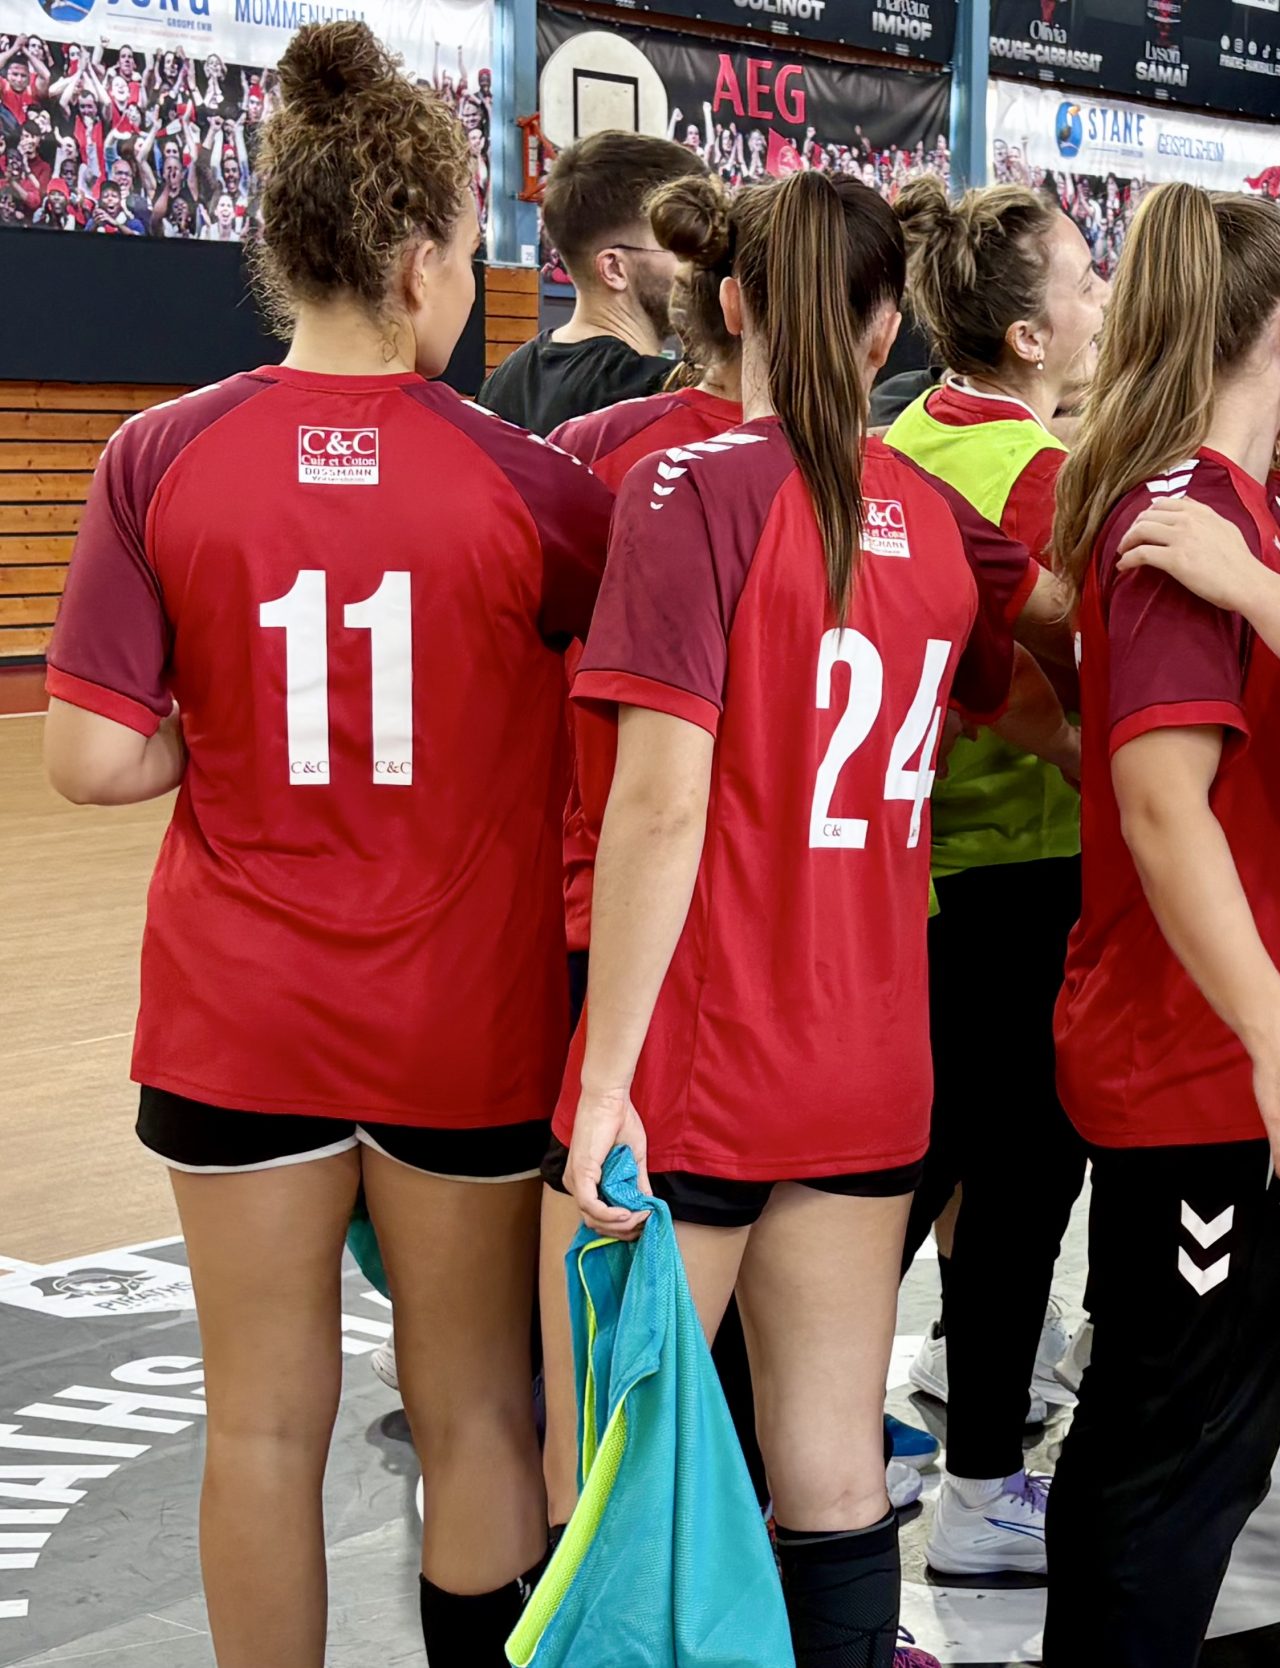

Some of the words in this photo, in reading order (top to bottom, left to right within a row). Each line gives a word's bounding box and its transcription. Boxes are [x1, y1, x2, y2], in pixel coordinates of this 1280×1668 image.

[872, 11, 933, 42] IMHOF
[713, 53, 807, 125] AEG
[1088, 107, 1146, 147] STANE
[302, 430, 376, 456] C&C
[301, 454, 327, 466] Cuir
[329, 457, 340, 466] et
[342, 455, 376, 466] Coton
[304, 467, 372, 477] DOSSMANN
[867, 502, 904, 528] &C
[259, 569, 413, 786] 11
[808, 626, 952, 849] 24
[290, 760, 328, 775] C&C
[374, 760, 412, 775] C&C
